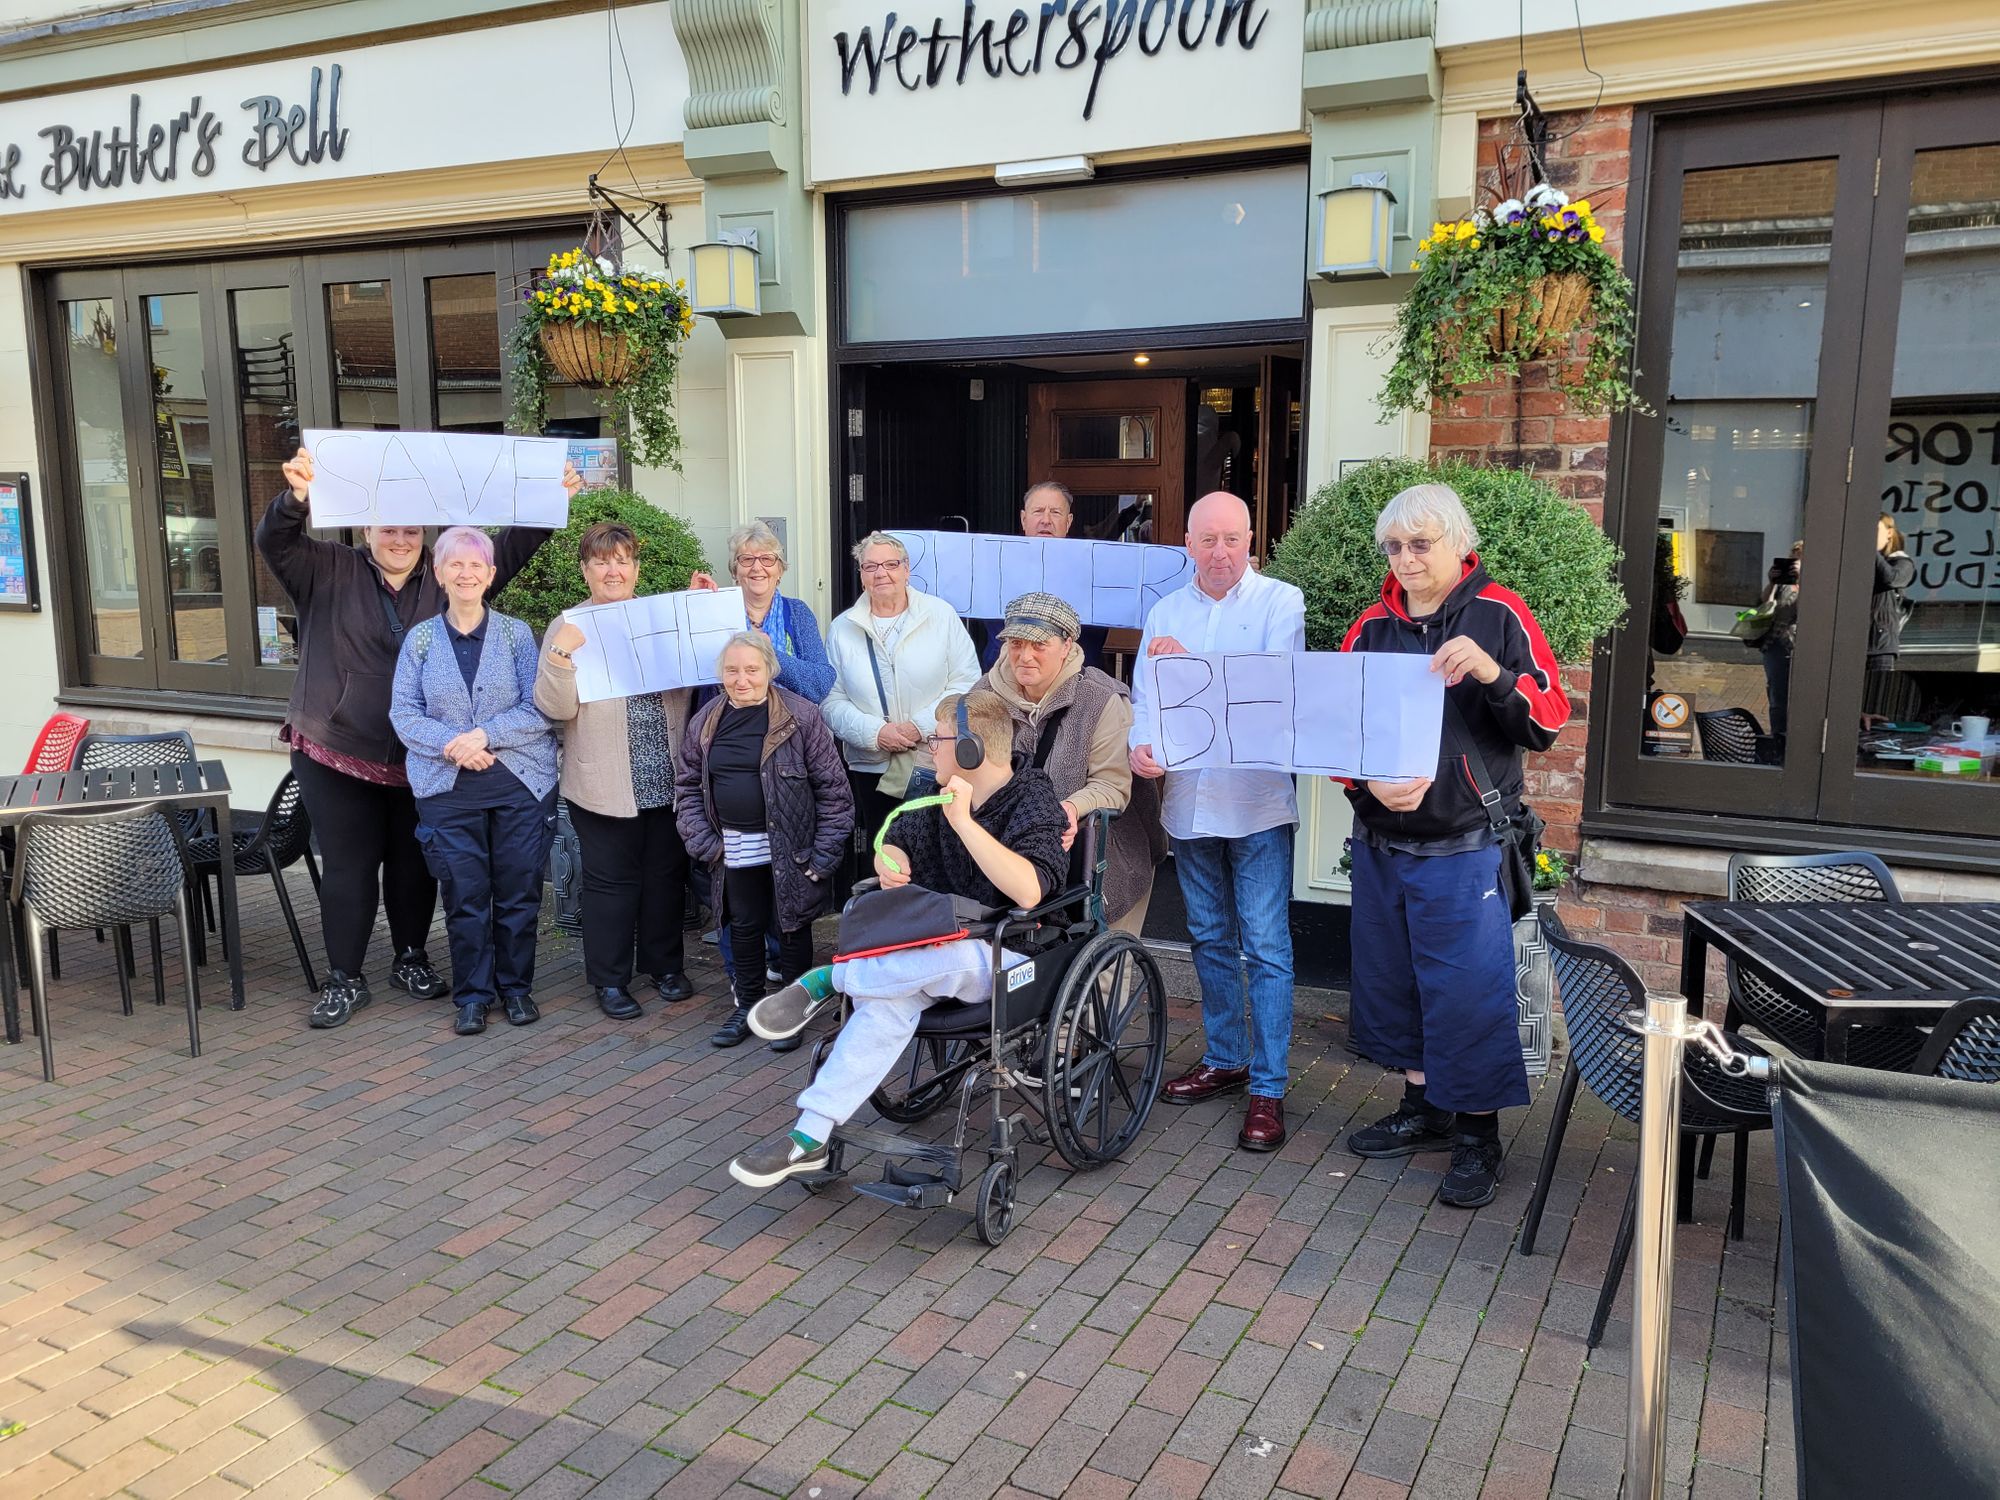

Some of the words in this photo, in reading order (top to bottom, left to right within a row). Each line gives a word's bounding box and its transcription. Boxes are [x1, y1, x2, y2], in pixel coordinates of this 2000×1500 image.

[37, 93, 223, 195] Butler's
[240, 63, 350, 172] Bell
[315, 434, 559, 525] SAVE
[566, 588, 739, 694] THE
[1155, 653, 1429, 780] BELL
[1008, 965, 1034, 987] drive
